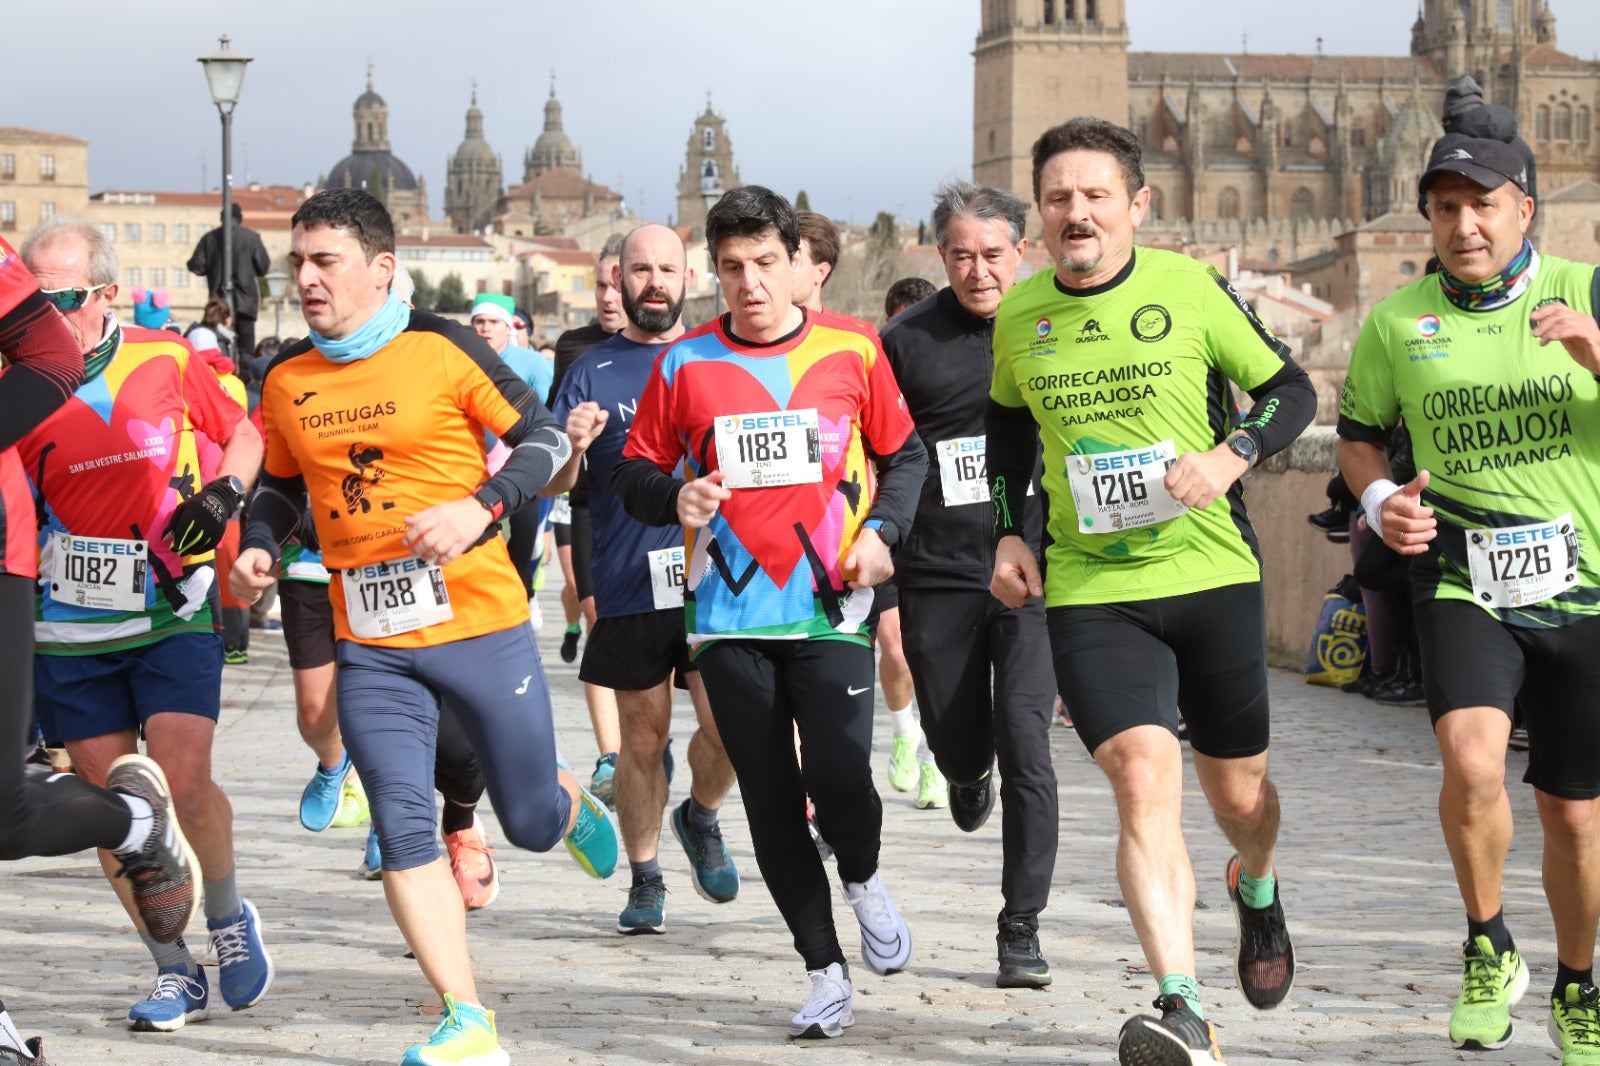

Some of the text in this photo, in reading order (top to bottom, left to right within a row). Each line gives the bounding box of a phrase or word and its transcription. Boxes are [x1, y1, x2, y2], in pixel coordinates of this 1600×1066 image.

[1404, 336, 1453, 347] CARBAJOSA
[1027, 361, 1172, 391] CORRECAMINOS
[1042, 383, 1157, 411] CARBAJOSA
[1423, 372, 1573, 421] CORRECAMINOS
[299, 401, 397, 431] TORTUGAS
[318, 421, 379, 439] RUNNING TEAM
[742, 414, 808, 430] SETEL
[1061, 406, 1145, 427] SALAMANCA
[1432, 408, 1573, 454] CARBAJOSA
[738, 431, 787, 463] 1183
[1094, 449, 1165, 472] SETEL
[1444, 442, 1571, 476] SALAMANCA
[69, 463, 85, 474] SAN
[85, 454, 123, 470] SILVESTRE
[1092, 470, 1147, 506] 1216
[1098, 502, 1126, 514] MATIAS
[72, 540, 137, 557] SETEL
[1495, 524, 1563, 547] SETEL
[65, 552, 117, 587] 1082
[1488, 544, 1552, 582] 1226
[359, 576, 416, 612] 1738
